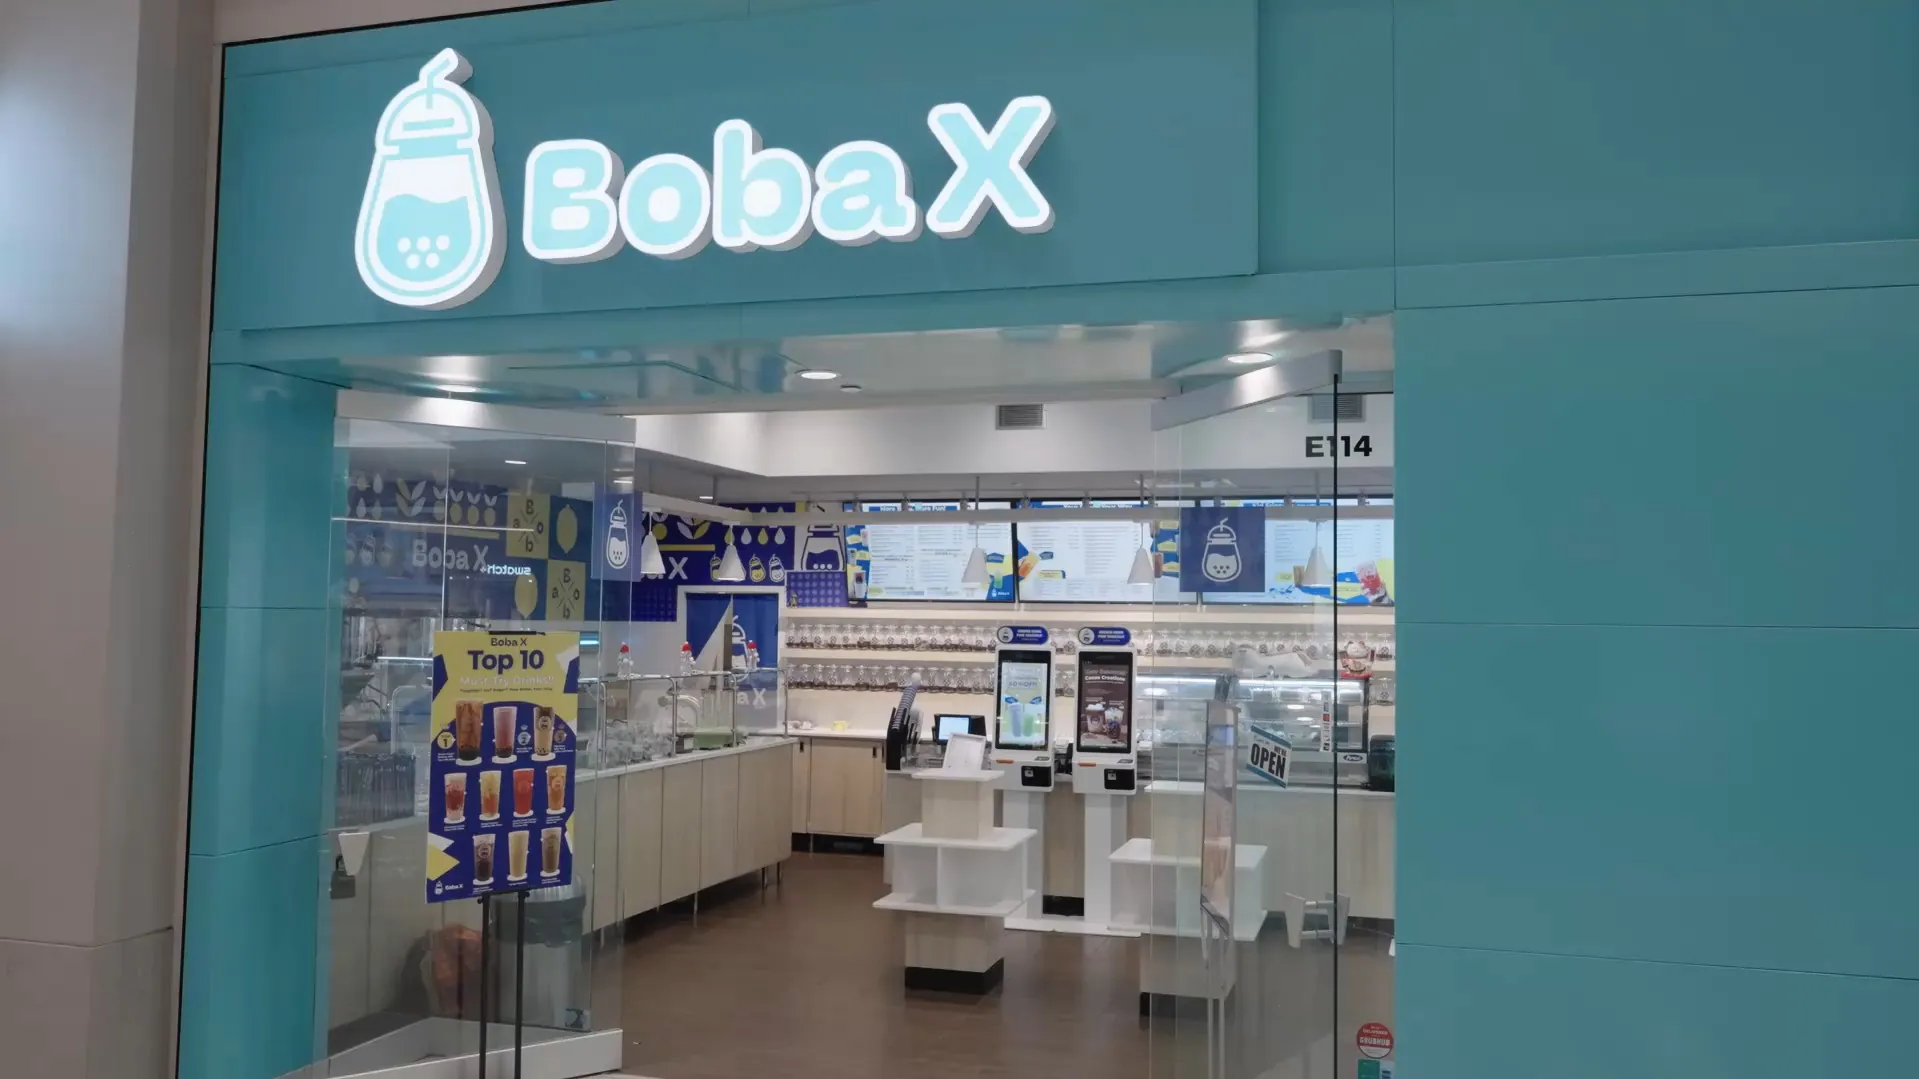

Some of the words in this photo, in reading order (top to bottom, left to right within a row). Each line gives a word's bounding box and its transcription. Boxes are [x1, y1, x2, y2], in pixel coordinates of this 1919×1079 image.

[523, 118, 917, 260] Boba
[927, 95, 1054, 233] X
[1305, 435, 1373, 458] E114
[668, 556, 689, 580] X
[490, 637, 518, 647] Boba
[520, 637, 528, 646] X
[467, 649, 514, 675] Top
[519, 649, 545, 670] 10
[459, 675, 509, 687] Must-Try
[752, 687, 768, 708] X
[1251, 742, 1286, 779] OPEN
